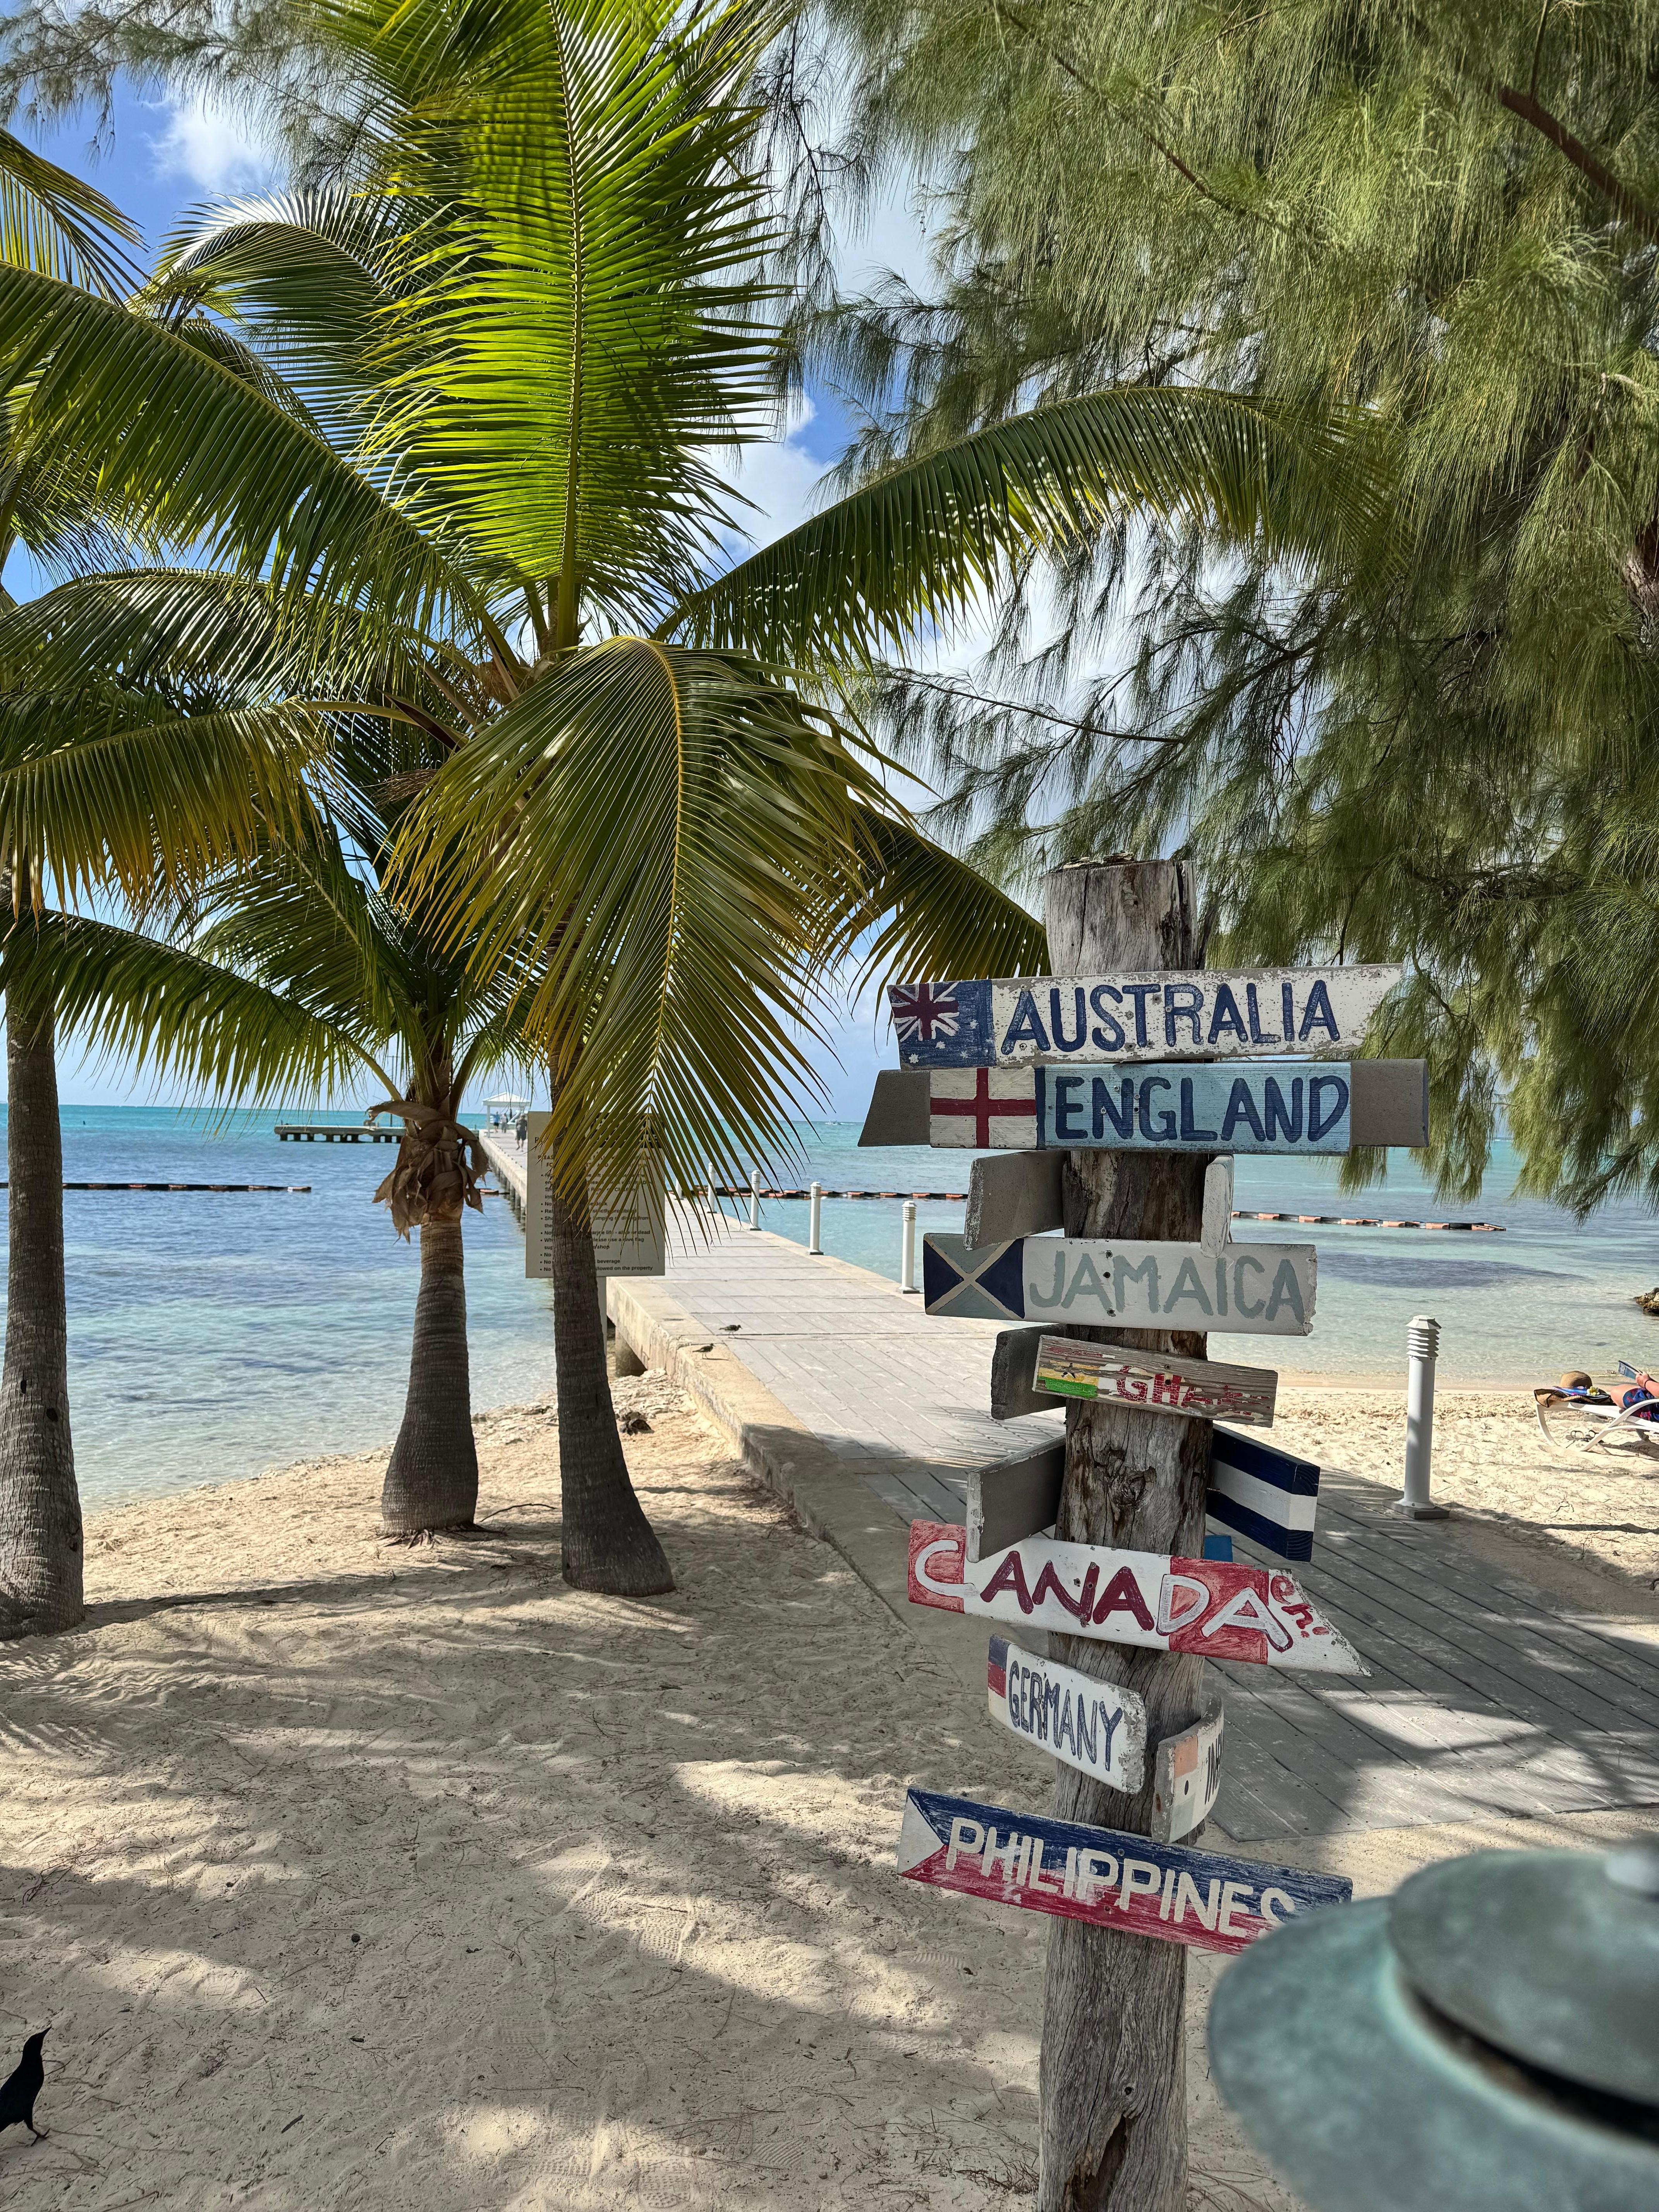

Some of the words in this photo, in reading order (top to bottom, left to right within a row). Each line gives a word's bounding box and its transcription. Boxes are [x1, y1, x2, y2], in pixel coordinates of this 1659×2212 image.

[1001, 980, 1340, 1054] AUSTRALIA
[1055, 1075, 1350, 1143] ENGLAND
[1029, 1250, 1304, 1321] JAMAICA
[915, 1539, 1293, 1652] CANADA
[1008, 1660, 1123, 1772] GERMANY
[945, 1817, 1296, 1938] PHILIPPINES
